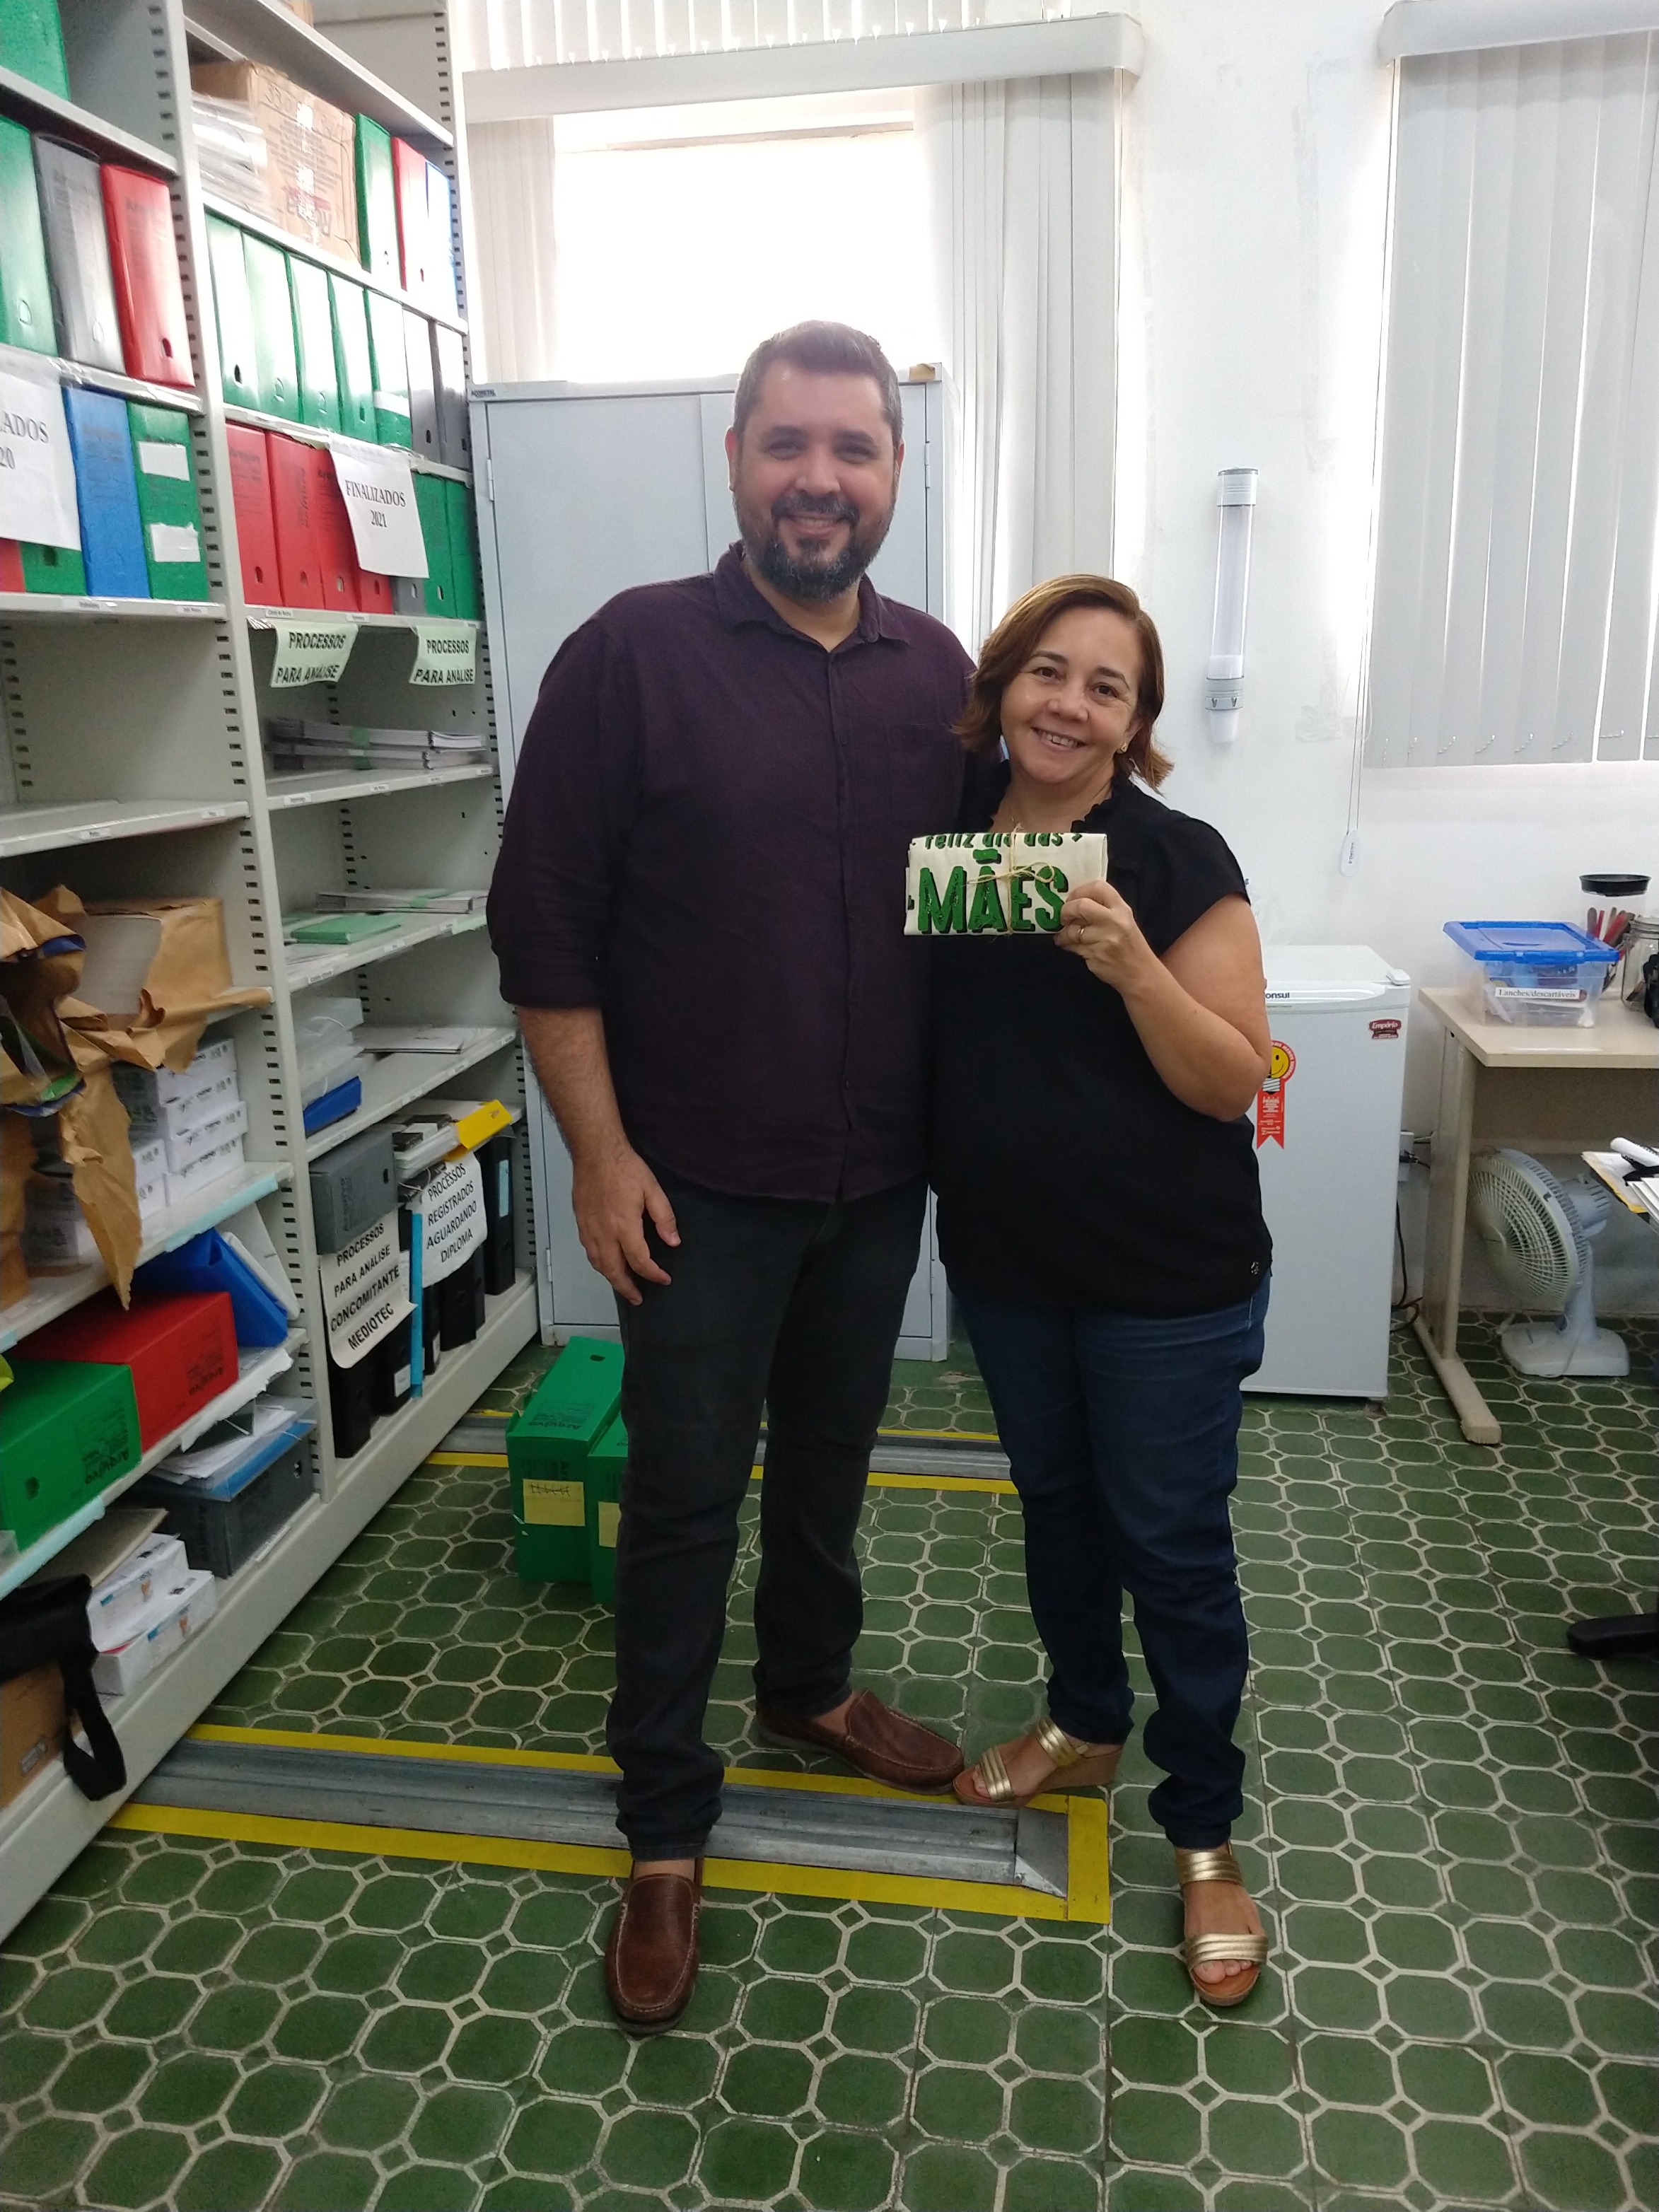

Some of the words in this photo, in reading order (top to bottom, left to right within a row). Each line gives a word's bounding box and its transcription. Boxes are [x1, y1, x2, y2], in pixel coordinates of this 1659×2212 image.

[0, 410, 49, 443] ADOS
[344, 479, 406, 507] FINALIZADOS
[369, 509, 388, 528] 2021
[289, 631, 347, 649] PROCESSOS
[426, 639, 470, 654] PROCESSOS
[276, 667, 303, 684] PARA
[414, 669, 443, 683] PARA
[918, 849, 1069, 934] MÃES
[429, 1163, 466, 1201] PROCESSOS
[428, 1180, 475, 1227] REGISTRADOS
[426, 1200, 477, 1250] AGUARDANDO
[337, 1223, 384, 1267] PROCESSOS
[441, 1228, 474, 1263] DIPLOMA
[330, 1264, 400, 1332] CONCOMITANTE
[334, 1272, 358, 1298] PARA
[347, 1303, 395, 1351] MEDIOTEC
